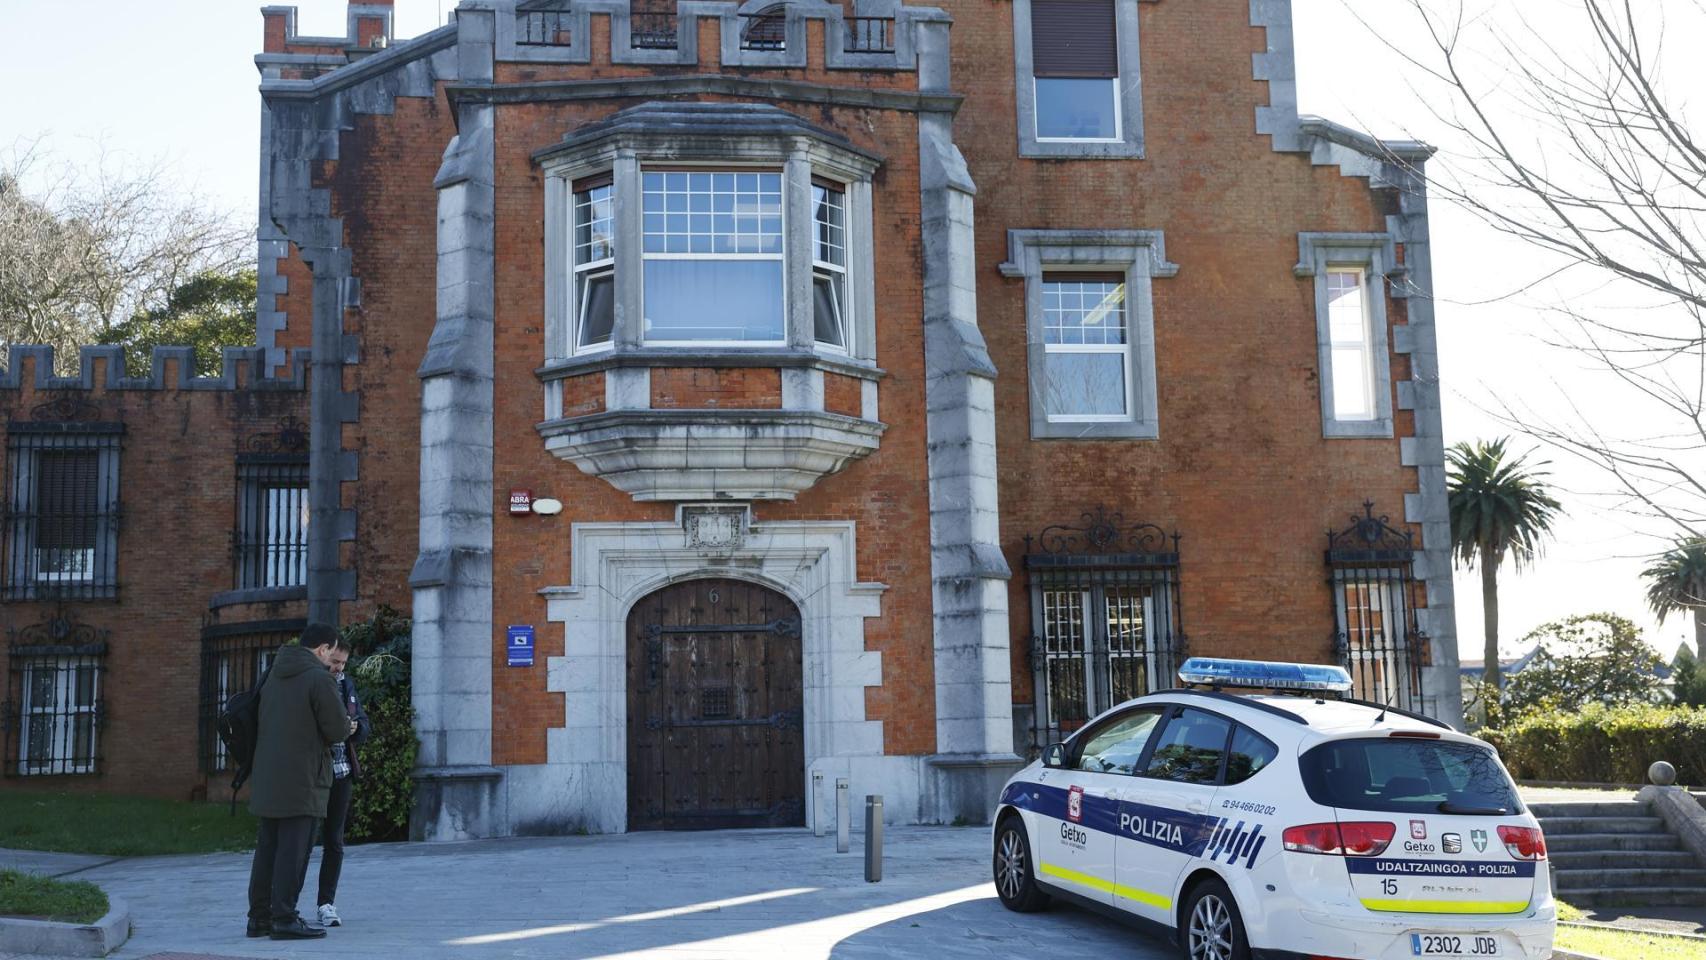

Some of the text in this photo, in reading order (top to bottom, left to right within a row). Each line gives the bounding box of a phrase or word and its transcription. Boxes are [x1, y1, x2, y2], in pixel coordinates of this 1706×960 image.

[709, 588, 719, 603] 6
[1060, 822, 1087, 845] Getxo
[1120, 812, 1183, 846] POLIZIA
[1404, 840, 1435, 852] Getxo
[1376, 861, 1517, 875] UDALTZAINGOA POLIZIA
[1380, 878, 1398, 896] 15
[1424, 936, 1497, 955] 2302 JDB
